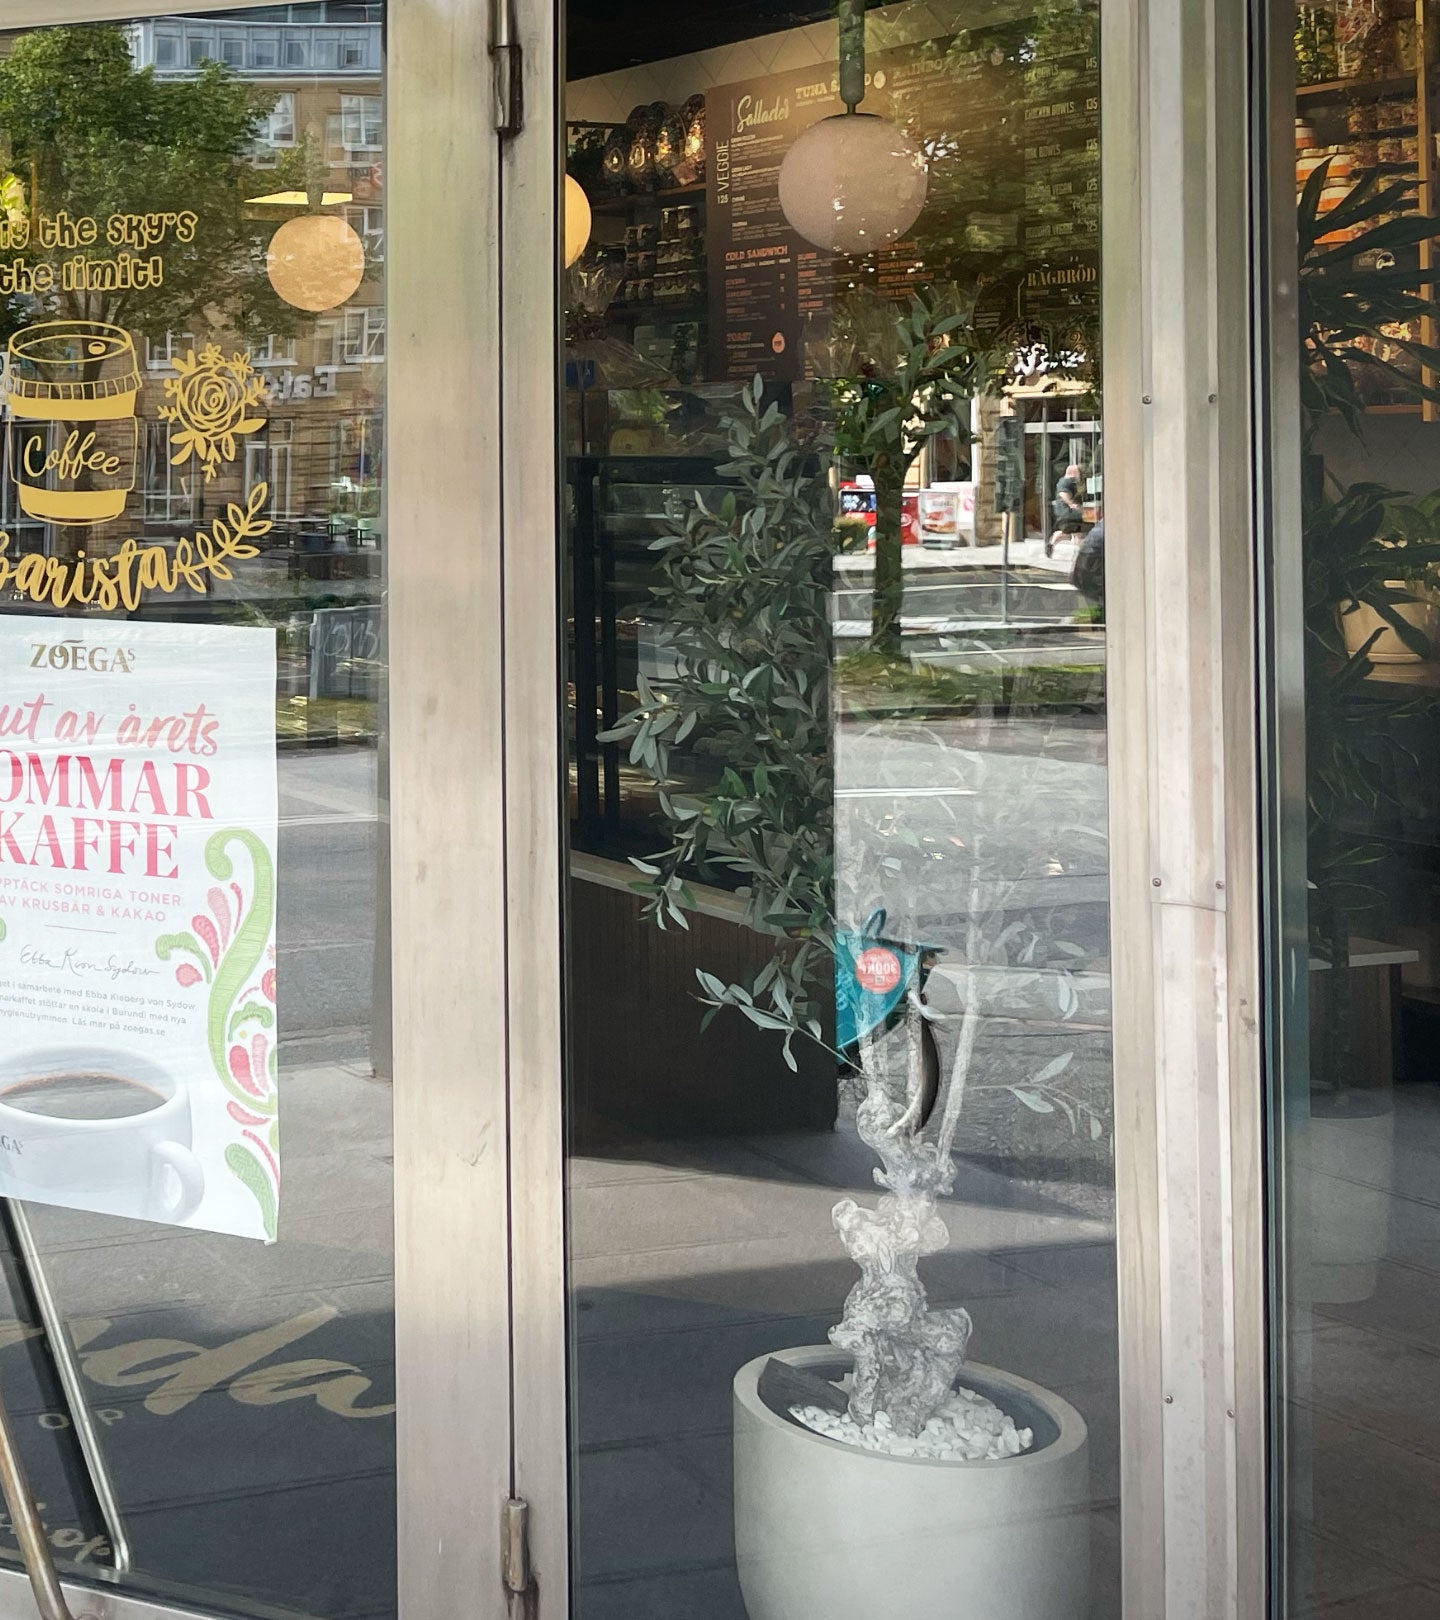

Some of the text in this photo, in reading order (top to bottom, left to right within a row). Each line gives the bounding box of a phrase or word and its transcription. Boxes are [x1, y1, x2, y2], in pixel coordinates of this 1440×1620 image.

[795, 82, 827, 99] TUNA
[737, 95, 789, 132] Sallader
[716, 140, 729, 191] VEGGIE
[39, 211, 98, 249] the
[746, 245, 788, 259] SANDWICH
[63, 253, 164, 291] limit!
[23, 429, 121, 480] Coffee
[55, 710, 105, 745] av
[117, 703, 220, 756] årets
[22, 898, 90, 915] KRUSBÄR
[96, 905, 105, 916] &
[111, 907, 166, 922] KAKAO
[54, 884, 122, 900] SOMRIGA
[128, 890, 181, 906] TONER
[64, 987, 83, 997] med
[149, 1012, 168, 1022] med
[171, 1016, 186, 1025] nya
